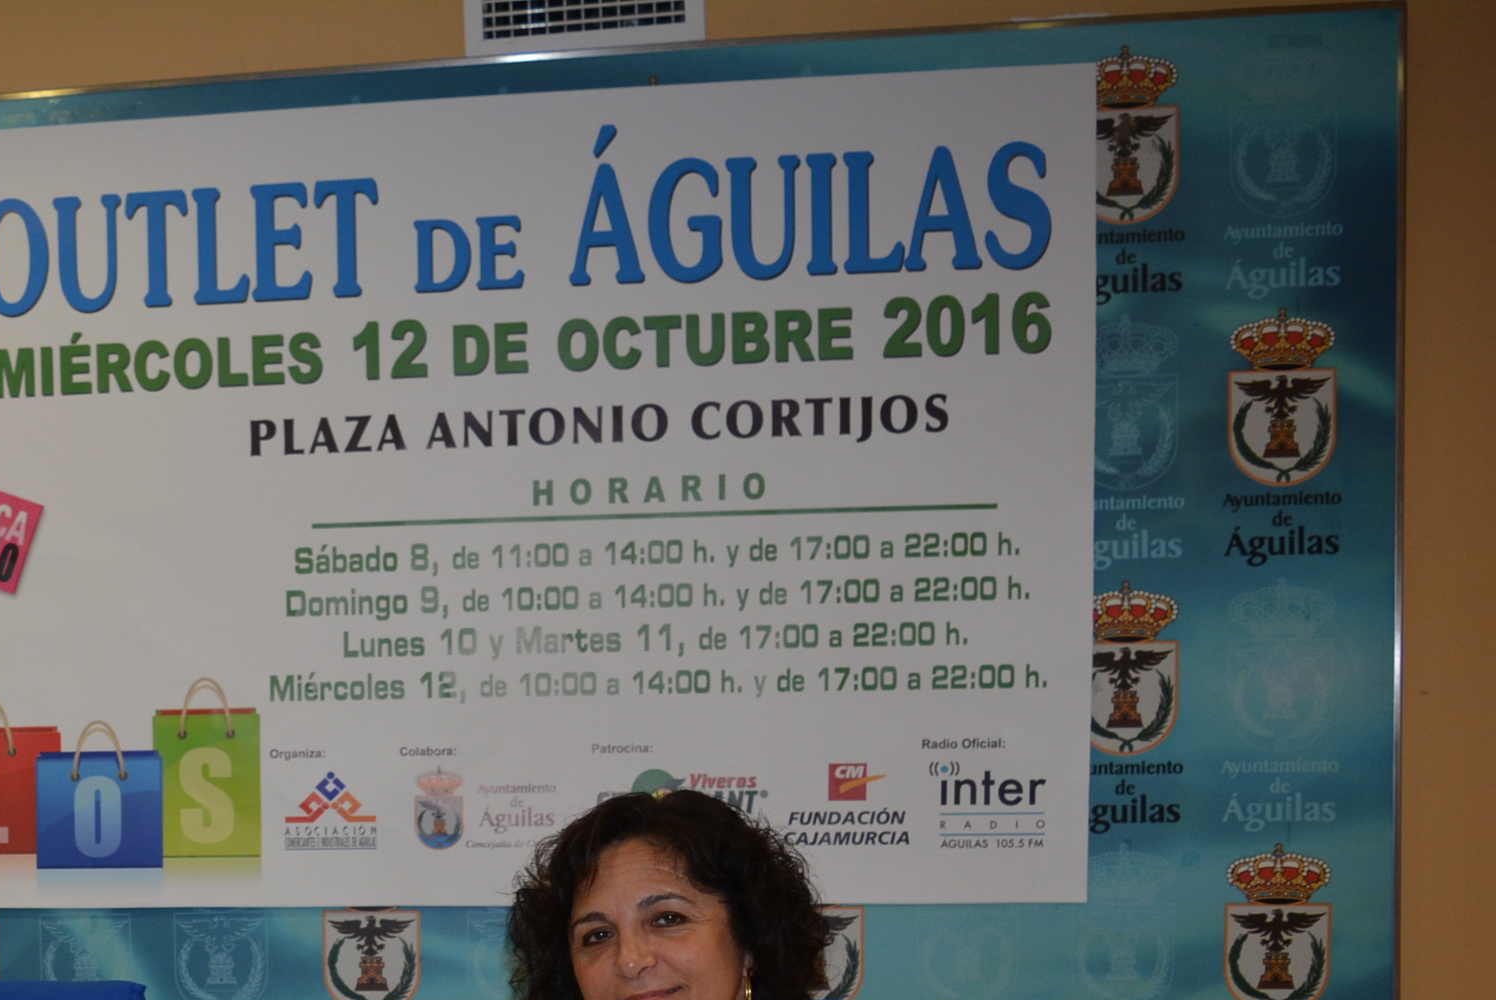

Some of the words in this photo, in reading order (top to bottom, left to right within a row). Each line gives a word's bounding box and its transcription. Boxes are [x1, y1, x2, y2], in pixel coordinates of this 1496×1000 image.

[413, 214, 526, 294] DE
[568, 123, 1053, 287] ÁGUILAS
[1224, 221, 1343, 245] Ayuntamiento
[1116, 249, 1136, 264] de
[1273, 242, 1294, 259] de
[1096, 264, 1182, 305] guilas
[1226, 257, 1341, 300] Águilas
[352, 318, 429, 381] 12
[452, 321, 530, 377] DE
[557, 306, 855, 373] OCTUBRE
[882, 290, 1053, 359] 2016
[249, 413, 407, 457] PLAZA
[426, 403, 669, 450] ANTONIO
[690, 392, 949, 443] CORTIJOS
[532, 471, 766, 507] HORARIO
[1223, 490, 1342, 512] Ayuntamiento
[1273, 510, 1292, 526] de
[294, 543, 399, 575] Sábado
[410, 542, 439, 577] 8,
[452, 545, 480, 571] de
[491, 542, 570, 569] 11:00
[578, 548, 593, 567] a
[604, 538, 684, 566] 14:00
[693, 538, 716, 564] h.
[726, 544, 740, 568] y
[749, 537, 778, 562] de
[790, 534, 871, 561] 17:00
[880, 540, 894, 559] a
[904, 531, 988, 558] 22:00
[997, 531, 1020, 557] h.
[1225, 525, 1339, 566] Águilas
[285, 588, 409, 622] Domingo
[420, 585, 449, 620] 9,
[462, 588, 490, 613] de
[501, 585, 580, 612] 10:00
[588, 591, 603, 610] a
[614, 582, 694, 609] 14:00
[703, 582, 725, 607] h.
[735, 588, 750, 612] y
[758, 580, 788, 606] de
[800, 577, 881, 605] 17:00
[889, 584, 904, 603] a
[914, 575, 998, 602] 22:00
[1007, 575, 1030, 601] h.
[343, 630, 426, 659] Lunes
[439, 627, 478, 656] 10
[488, 634, 505, 662] y
[516, 625, 622, 654] Martes
[636, 623, 685, 658] 11,
[698, 625, 728, 651] de
[739, 623, 820, 650] 17:00
[828, 629, 843, 649] a
[852, 620, 936, 648] 22:00
[945, 620, 968, 646] h.
[269, 671, 406, 702] Miércoles
[419, 671, 466, 704] 12,
[479, 673, 508, 699] de
[519, 670, 598, 697] 10:00
[606, 677, 620, 696] a
[632, 668, 711, 695] 14:00
[720, 668, 743, 694] h.
[753, 674, 768, 699] y
[776, 667, 805, 693] de
[818, 665, 898, 692] 17:00
[907, 672, 921, 691] a
[931, 663, 1016, 690] 22:00
[1025, 663, 1048, 689] h.
[400, 746, 457, 757] Colabora:
[592, 744, 653, 754] Patrocina:
[922, 739, 957, 750] Radio
[962, 738, 1006, 749] Oficial:
[270, 749, 325, 760] Organiza:
[834, 765, 865, 779] CM
[1221, 759, 1339, 778] Ayuntamiento
[478, 784, 556, 796] Ayuntamiento
[689, 774, 756, 788] Viveros
[941, 770, 1046, 805] inter
[1115, 780, 1135, 795] de
[1270, 777, 1289, 793] de
[510, 797, 523, 808] de
[479, 808, 555, 834] Águilas
[788, 808, 905, 825] FUNDACIÓN
[1089, 795, 1180, 834] guilas
[1223, 793, 1337, 832] Águilas
[940, 820, 1045, 829] RADIO
[784, 831, 910, 845] CAJAMURCIA
[941, 837, 988, 848] ÁGUILAS
[997, 839, 1025, 848] 105.5
[1029, 839, 1044, 848] FM
